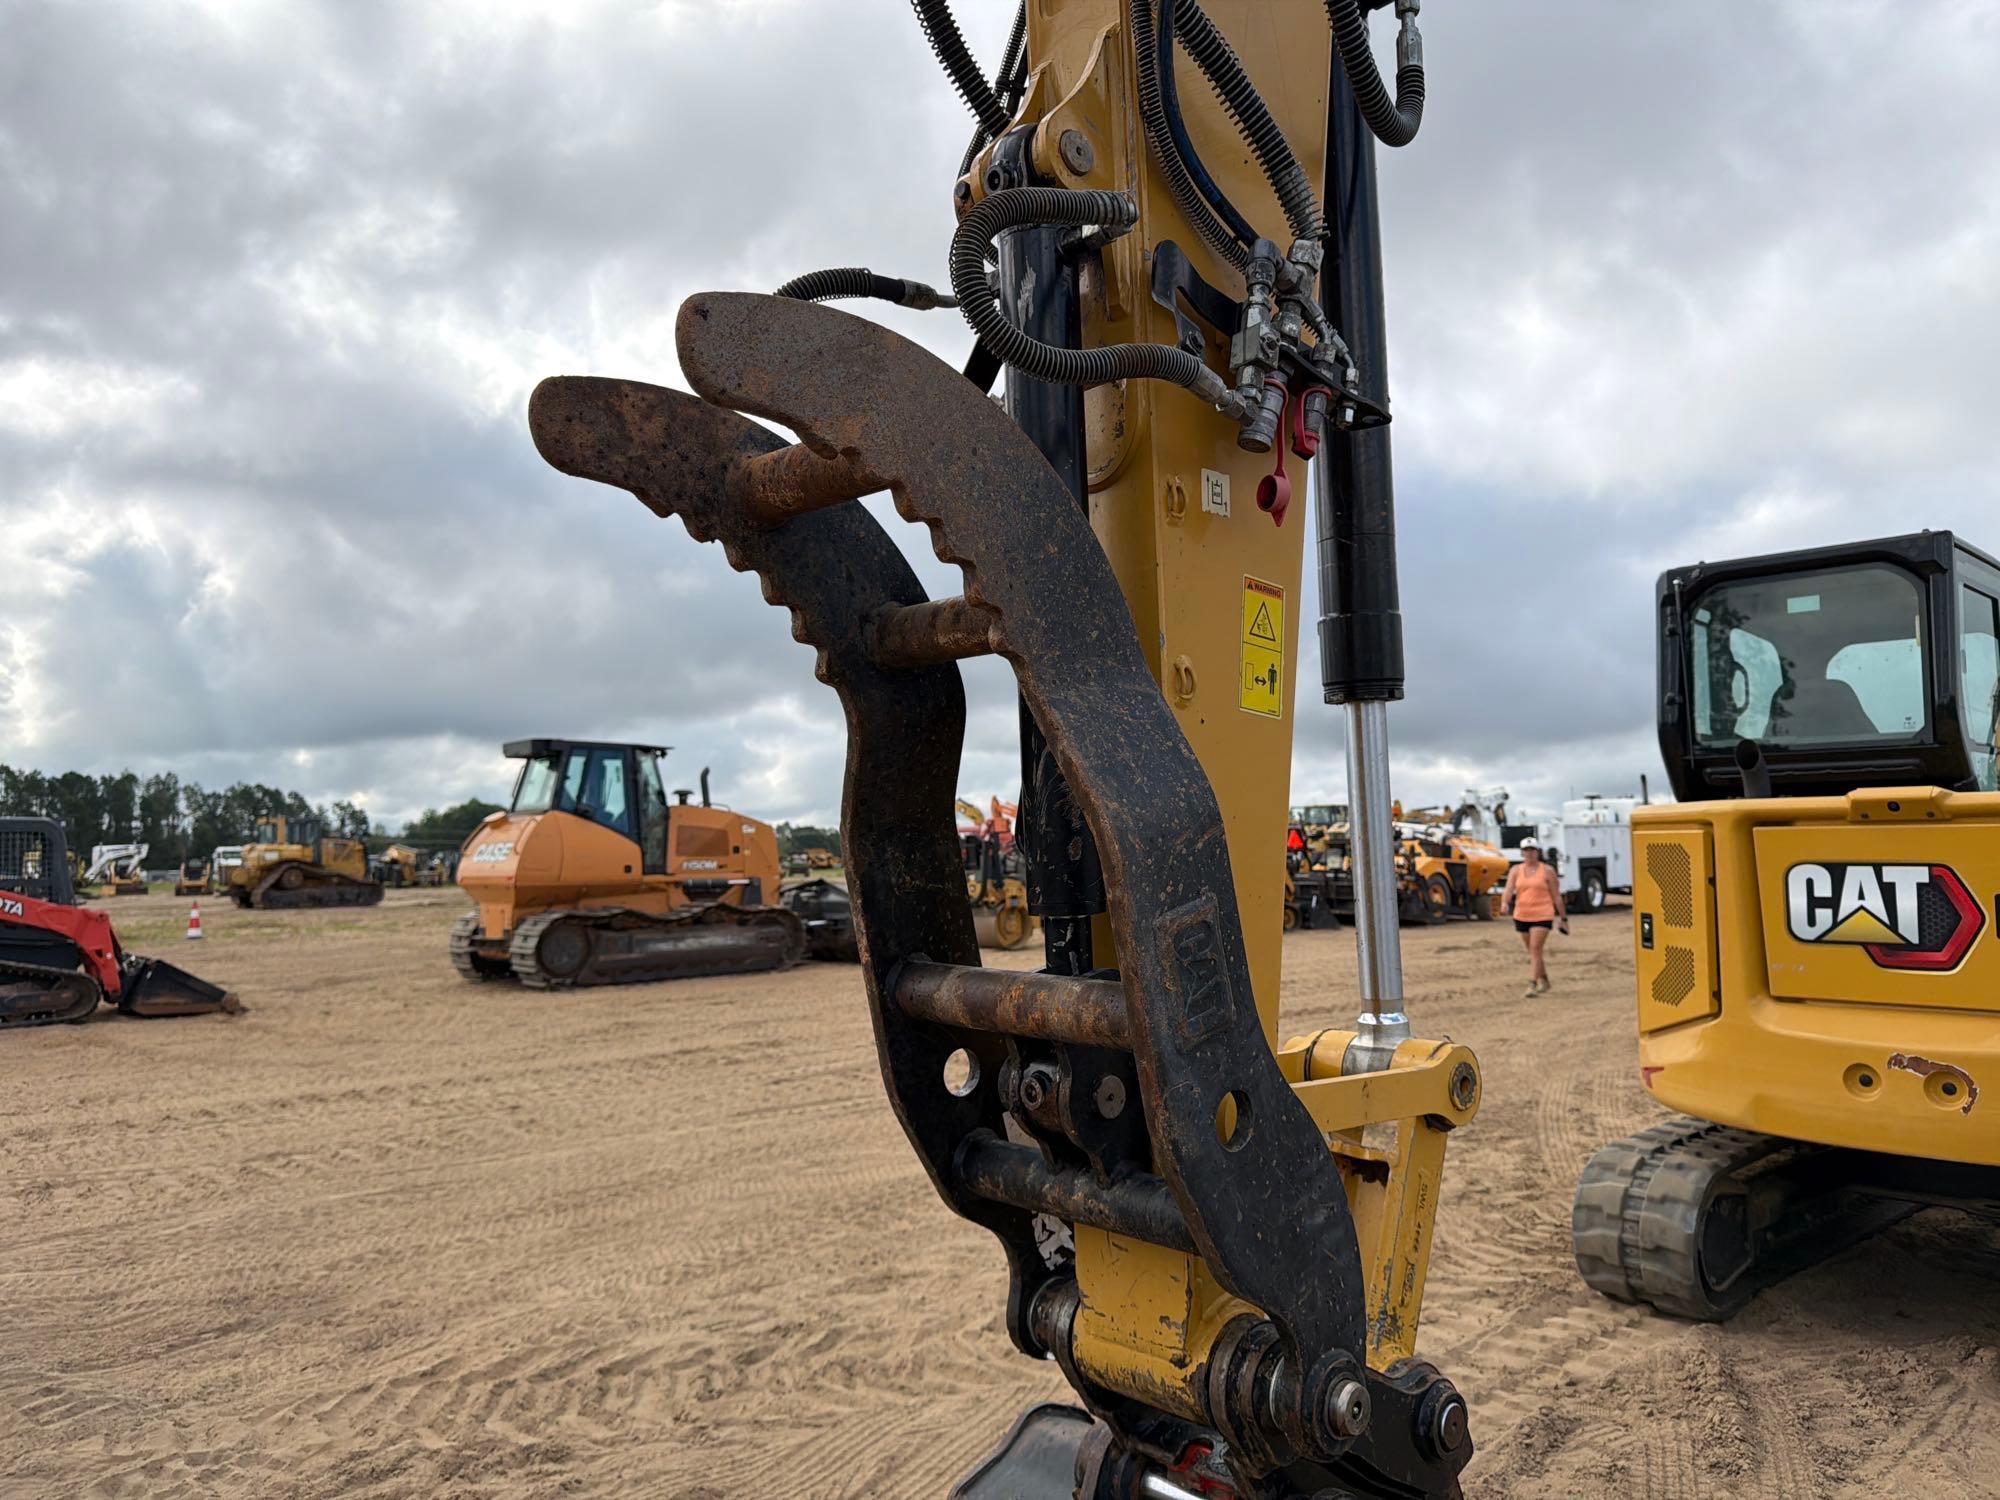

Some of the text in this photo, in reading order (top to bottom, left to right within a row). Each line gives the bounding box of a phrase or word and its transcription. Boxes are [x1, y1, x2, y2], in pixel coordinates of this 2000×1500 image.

[1254, 581, 1281, 598] WARNING
[472, 842, 514, 863] CASE
[1788, 863, 1929, 944] CAT
